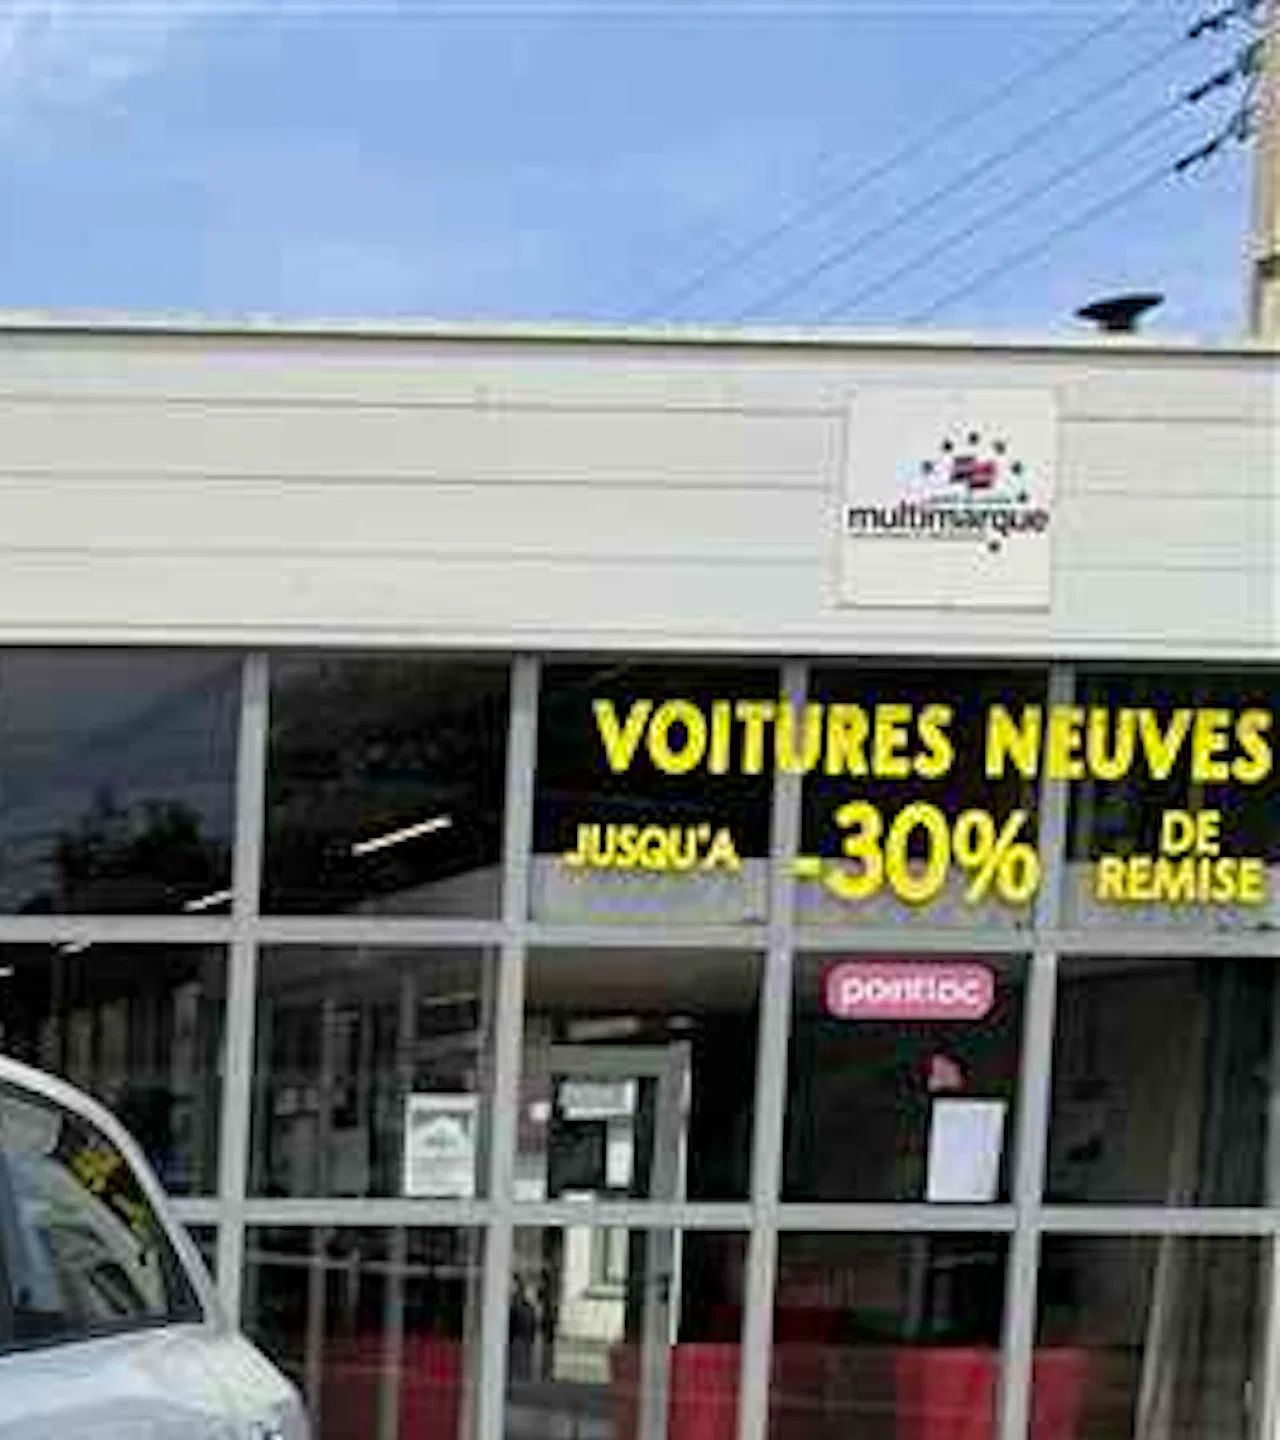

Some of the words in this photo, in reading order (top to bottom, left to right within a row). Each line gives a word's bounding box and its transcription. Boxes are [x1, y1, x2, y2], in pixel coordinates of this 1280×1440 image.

[846, 500, 1050, 538] multimarque
[592, 697, 956, 778] VOITURES
[984, 704, 1274, 784] NEUVES
[562, 822, 742, 872] JUSQU'A
[784, 799, 1040, 902] -30%
[1159, 809, 1222, 856] DE
[1093, 855, 1265, 903] REMISE
